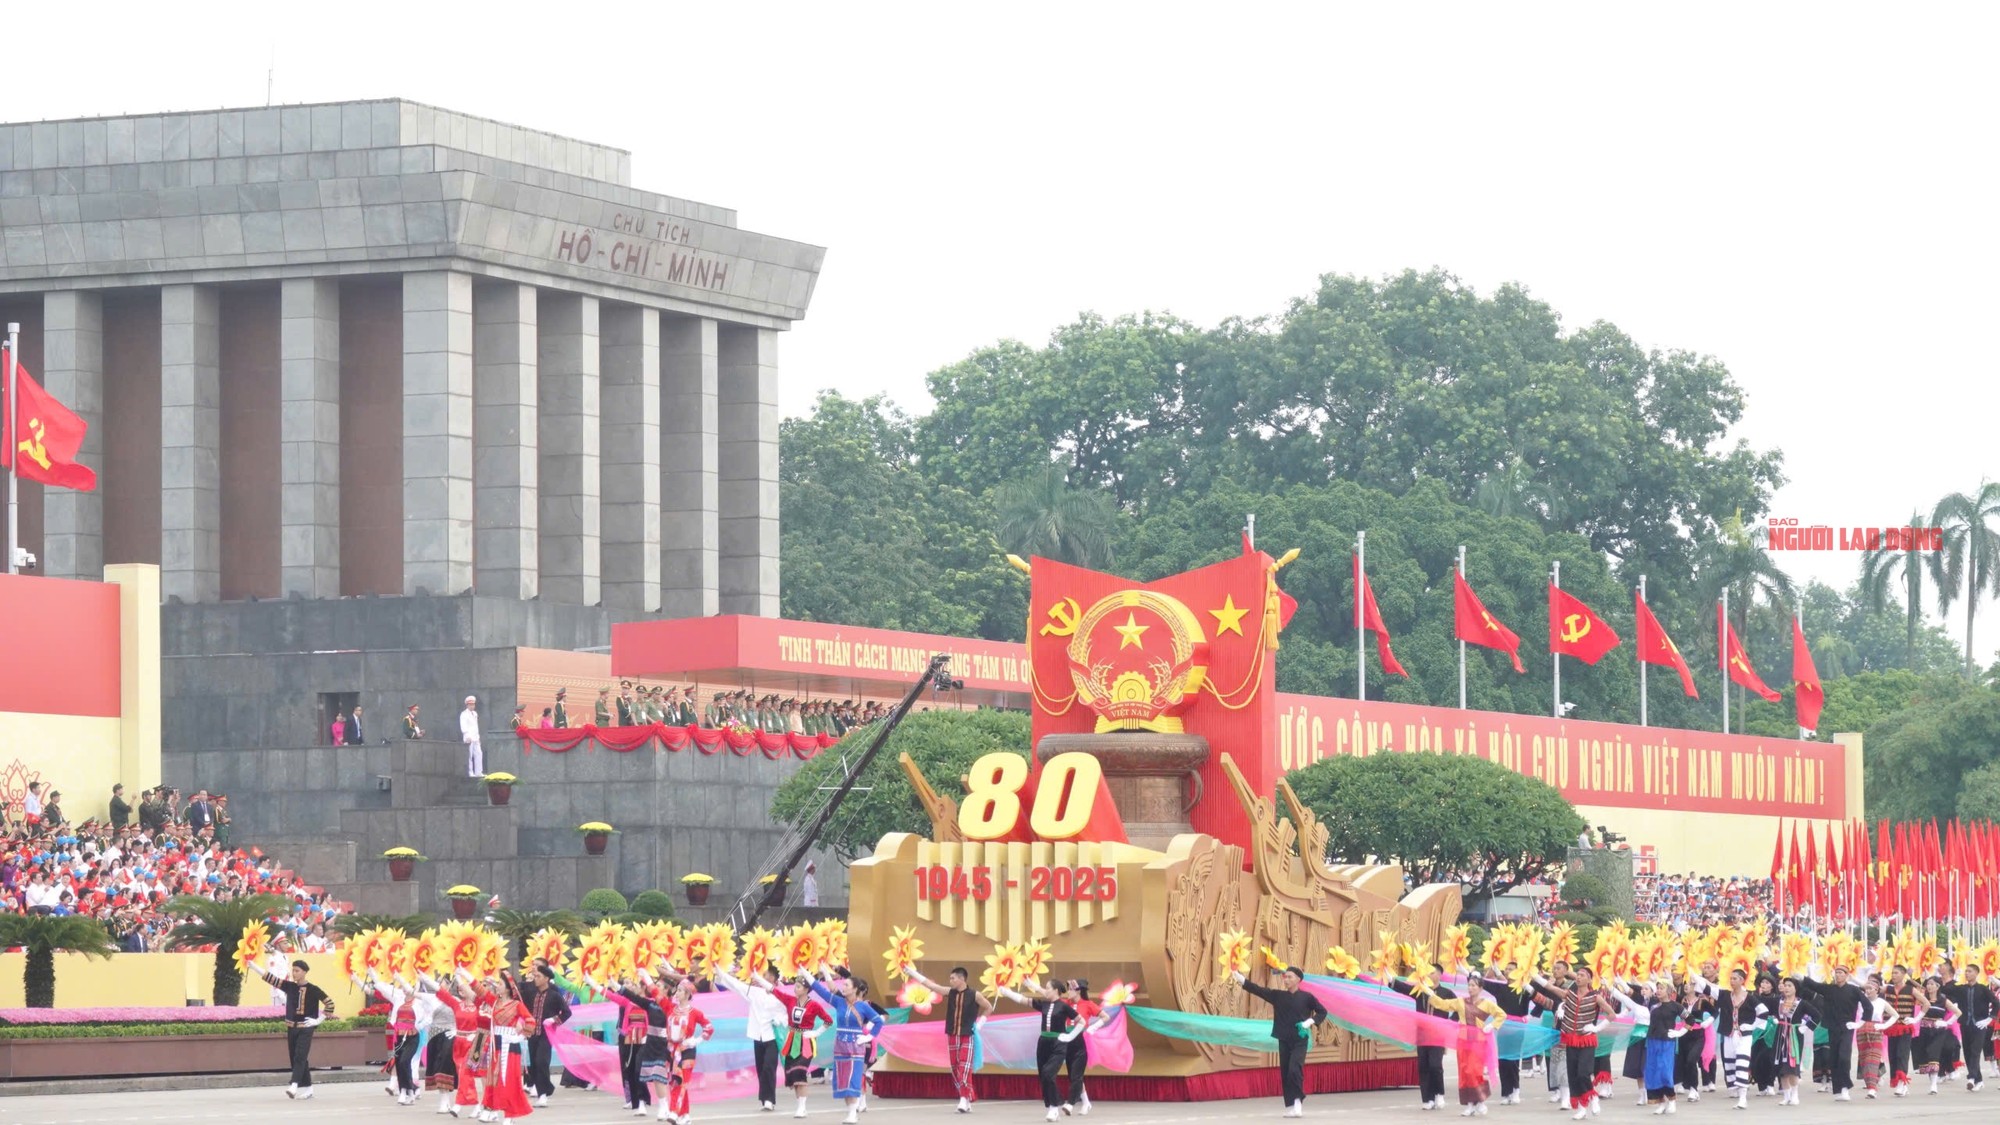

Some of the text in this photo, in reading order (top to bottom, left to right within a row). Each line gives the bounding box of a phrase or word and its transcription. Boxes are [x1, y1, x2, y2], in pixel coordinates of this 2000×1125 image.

[667, 248, 729, 290] MINH
[779, 635, 812, 663] TINH
[855, 638, 888, 670] CÁCH
[891, 646, 927, 677] MẠNG
[973, 650, 999, 680] TÁM
[1002, 652, 1018, 682] VÀ
[1111, 707, 1150, 718] VIỆT NAM
[1280, 706, 1324, 771] ƯỚC
[1533, 724, 1568, 790] CHỦ
[1579, 734, 1634, 793] NGHĨA
[1642, 737, 1679, 804] VIỆT
[1688, 748, 1722, 798] NAM
[1732, 745, 1776, 802] MUÔN
[958, 752, 1101, 839] 80
[913, 866, 992, 900] 1945
[1030, 866, 1117, 901] 2025
